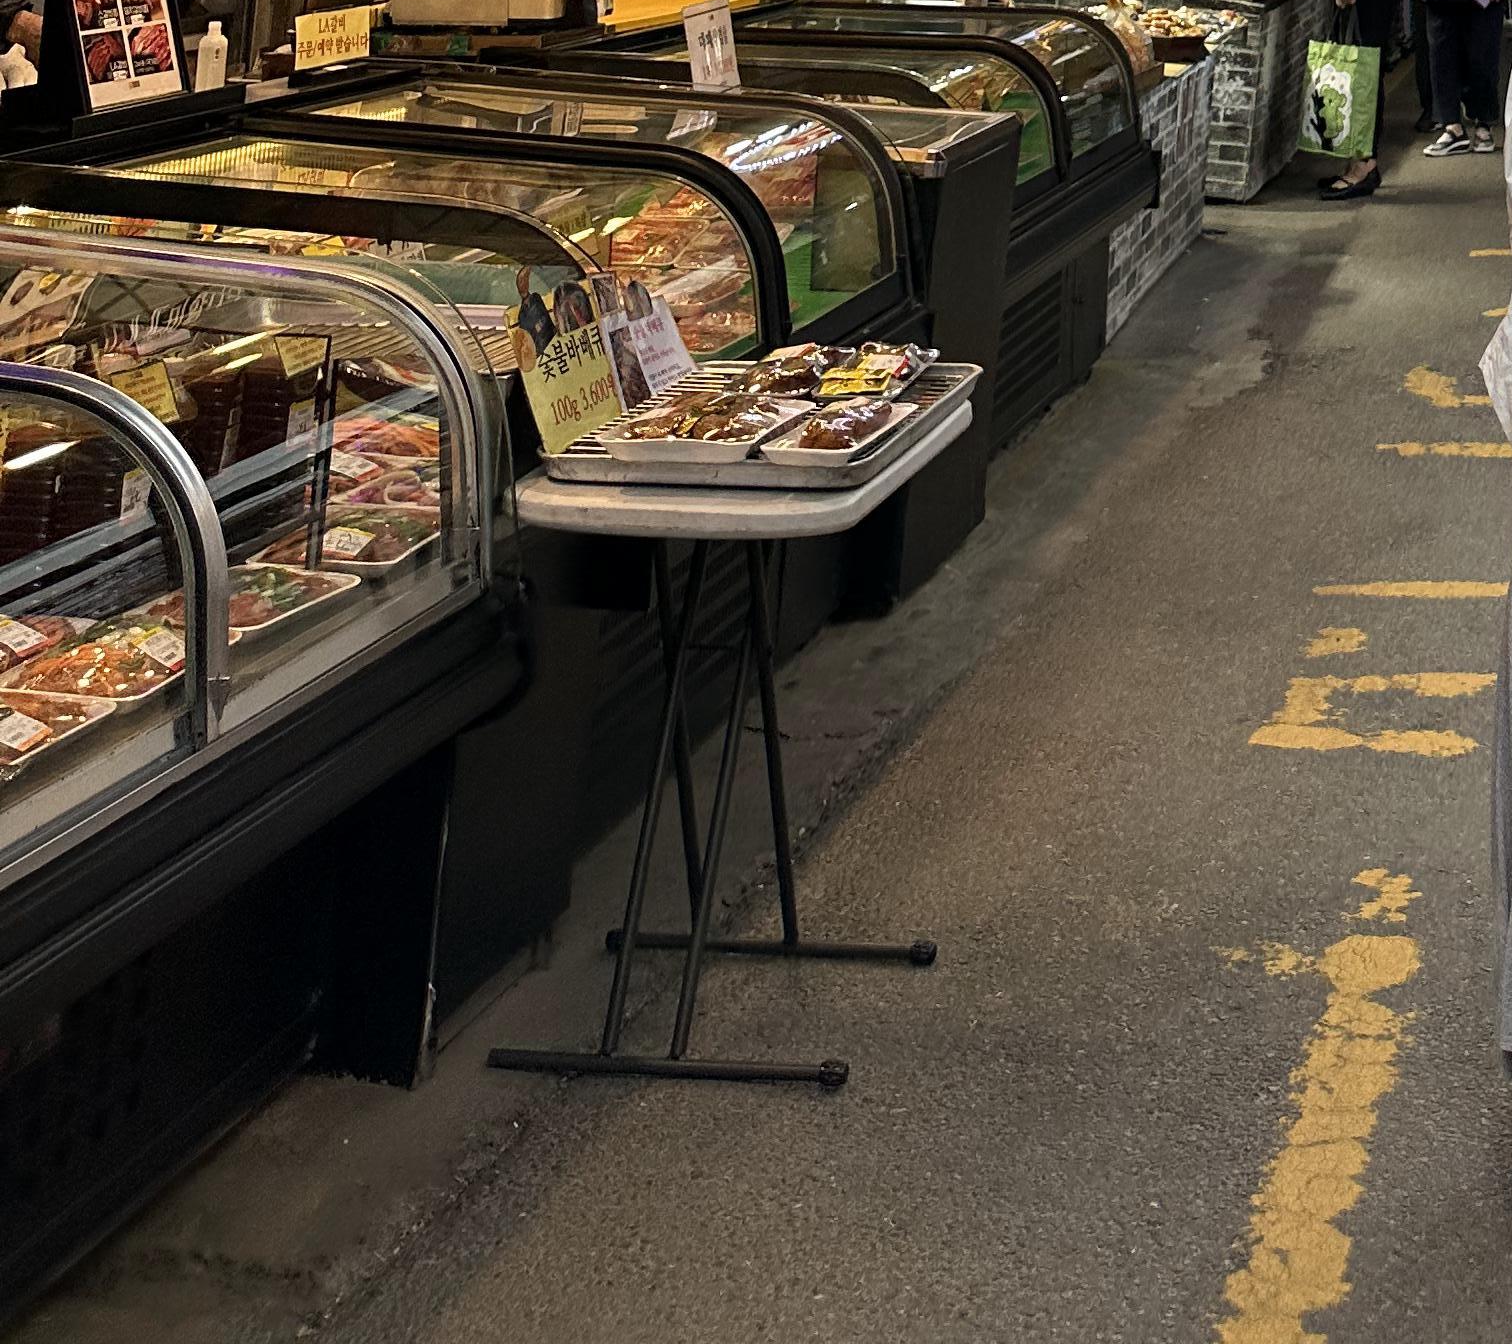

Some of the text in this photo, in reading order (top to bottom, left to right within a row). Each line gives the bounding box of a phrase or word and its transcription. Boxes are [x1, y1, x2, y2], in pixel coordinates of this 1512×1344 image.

[318, 14, 347, 34] LA갈비
[538, 324, 606, 383] 숯불바베큐
[551, 394, 582, 425] 100g
